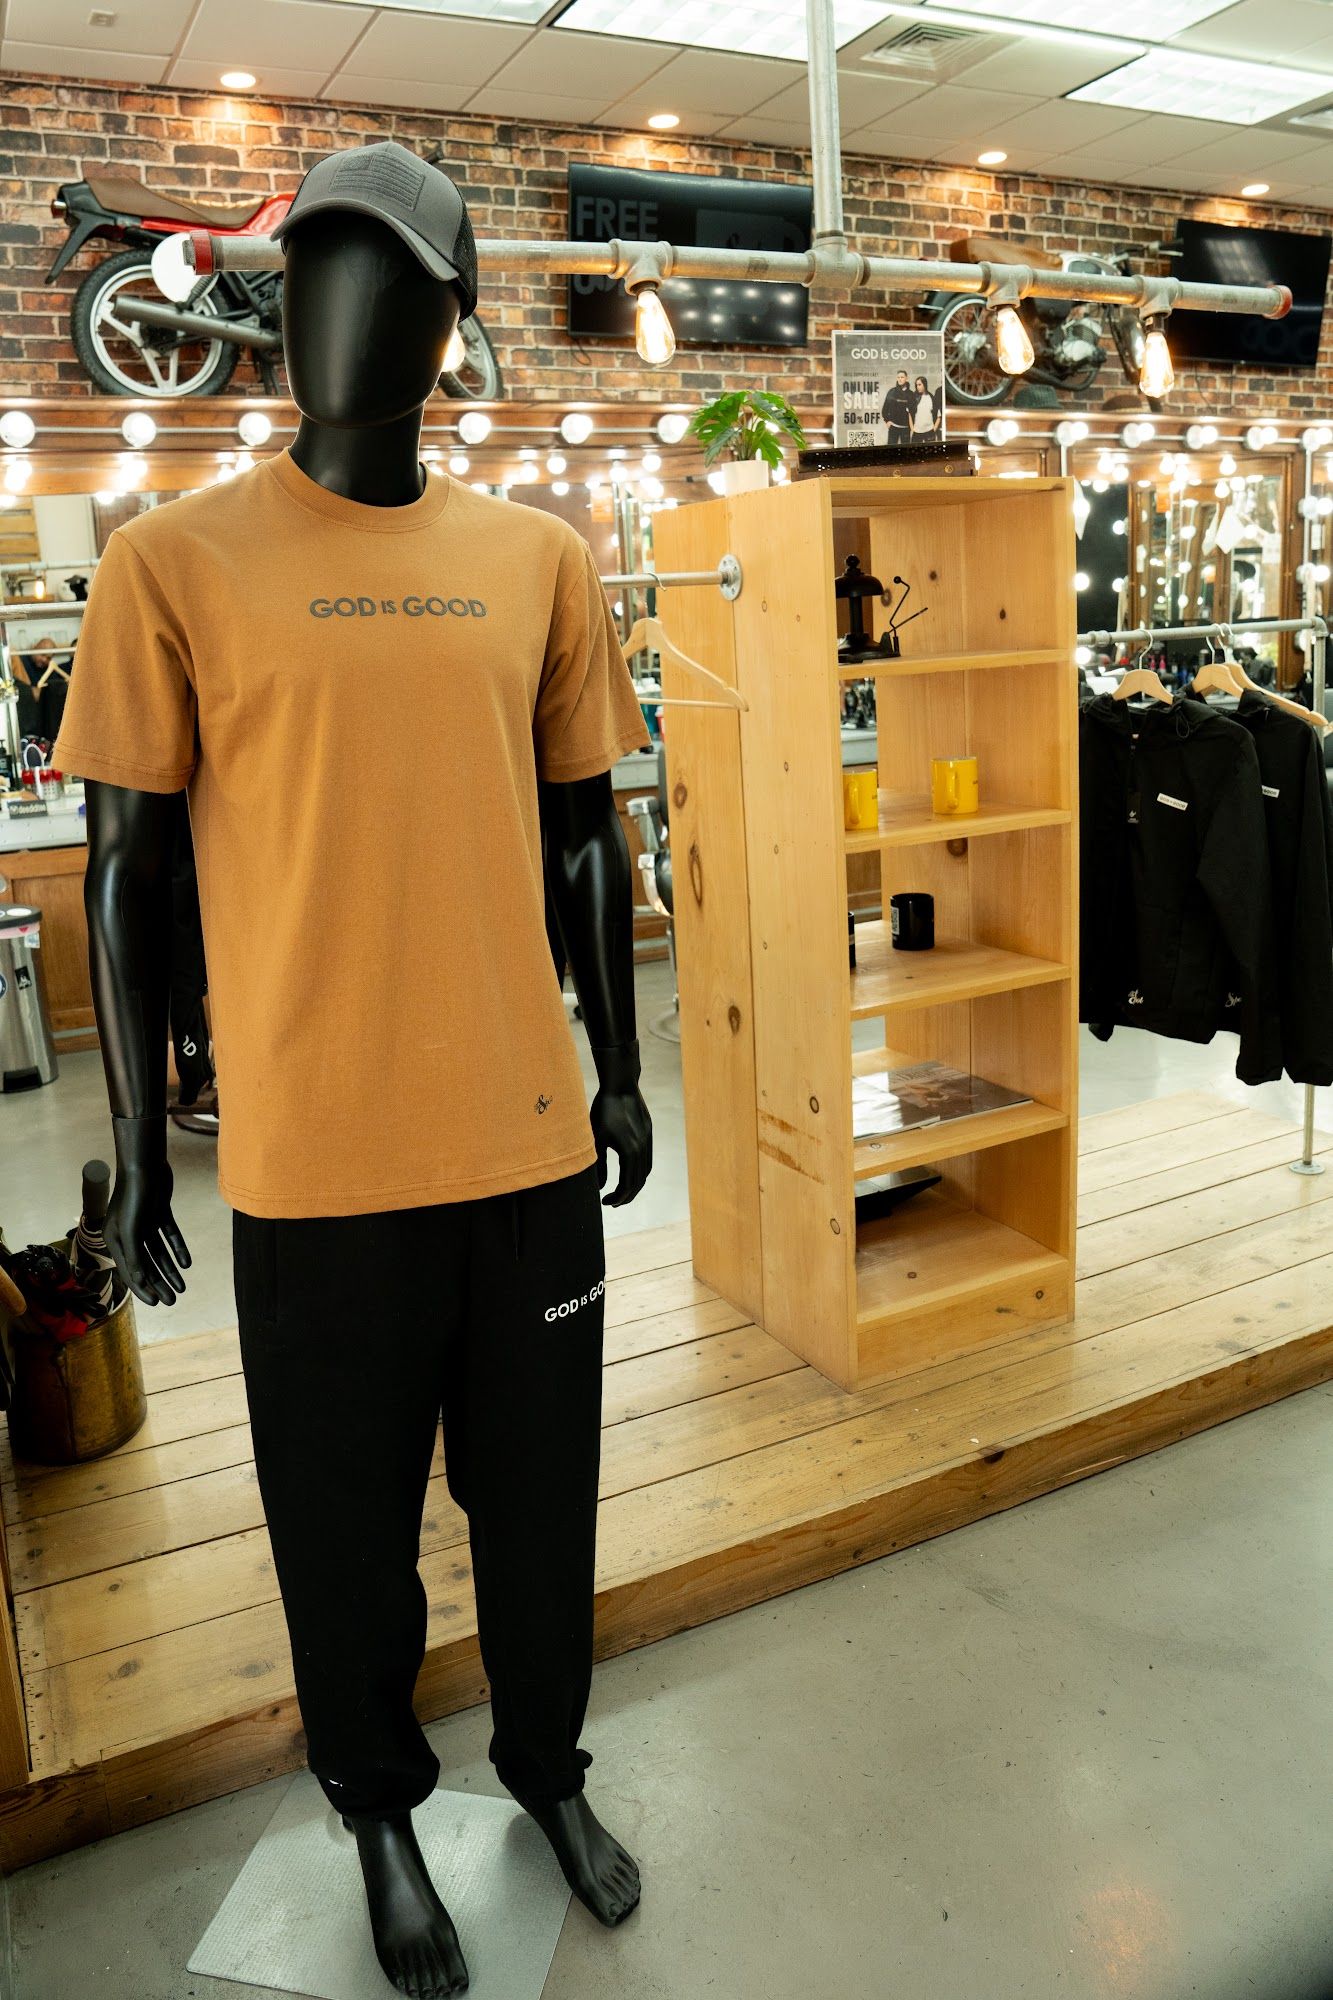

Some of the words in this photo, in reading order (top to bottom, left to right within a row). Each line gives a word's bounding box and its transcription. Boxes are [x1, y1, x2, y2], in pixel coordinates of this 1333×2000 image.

[575, 196, 658, 241] FREE
[851, 348, 878, 360] GOD
[880, 348, 888, 360] is
[890, 348, 927, 360] GOOD
[843, 380, 880, 395] ONLINE
[843, 391, 880, 410] SALE
[309, 596, 377, 618] GOD
[381, 599, 397, 615] IS
[402, 595, 487, 618] GOOD
[544, 1298, 579, 1322] GOD
[580, 1294, 588, 1307] IS
[589, 1276, 606, 1302] GO
